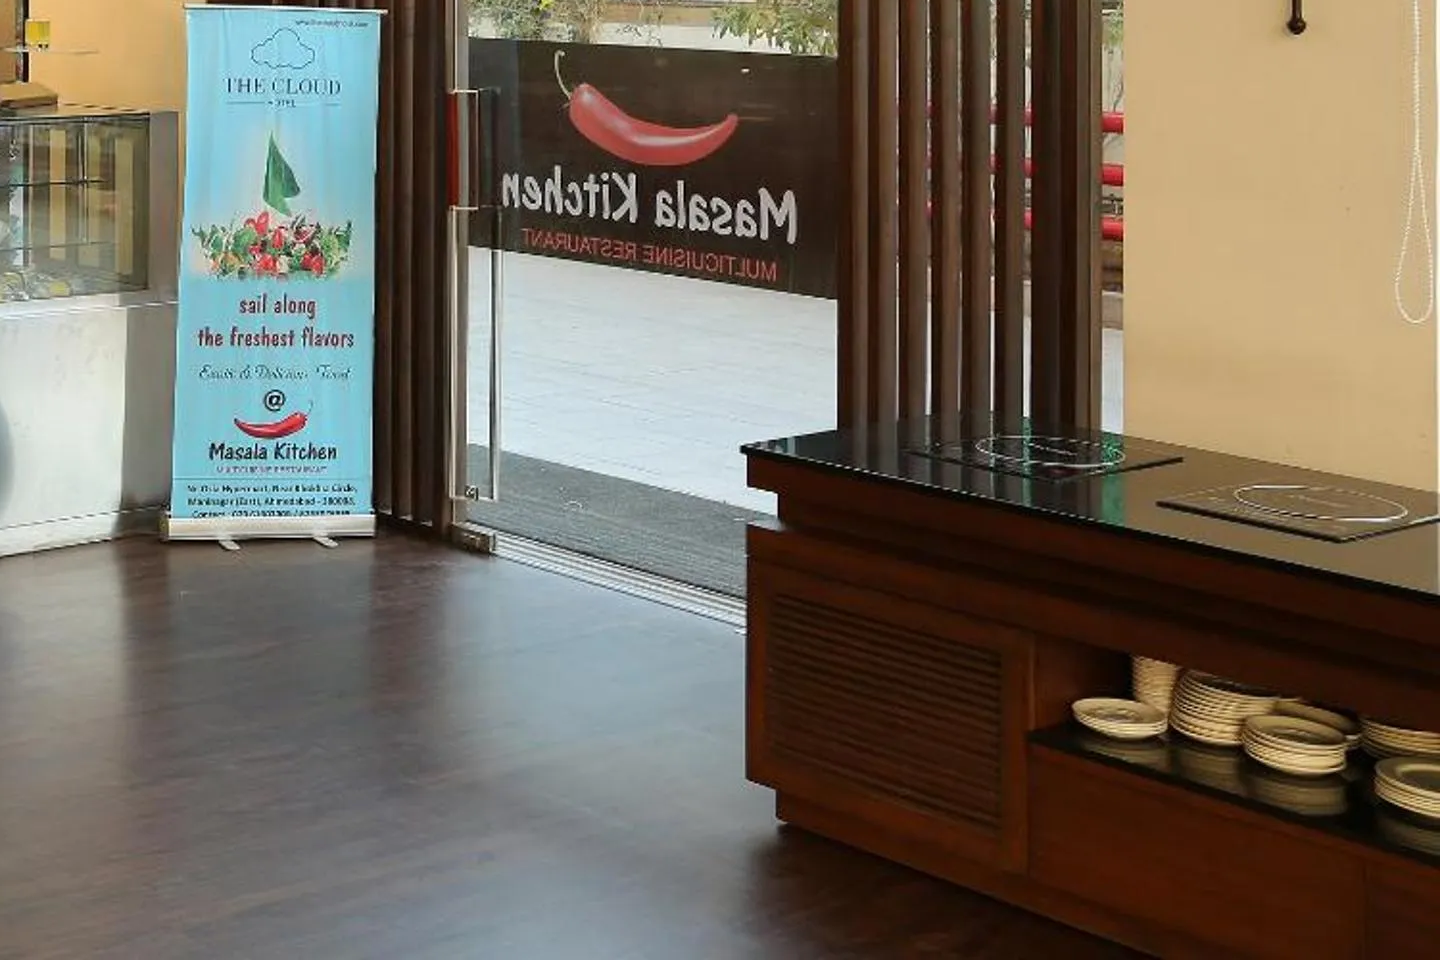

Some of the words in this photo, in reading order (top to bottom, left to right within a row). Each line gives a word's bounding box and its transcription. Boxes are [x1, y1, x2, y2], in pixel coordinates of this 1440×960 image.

[224, 77, 266, 94] THE
[272, 77, 341, 96] CLOUD
[239, 293, 267, 314] sail
[274, 294, 316, 319] along
[197, 328, 223, 347] the
[230, 326, 295, 348] freshest
[301, 326, 355, 348] flavors
[263, 389, 286, 412] @
[209, 442, 268, 461] Masala
[274, 441, 337, 461] Kitchen
